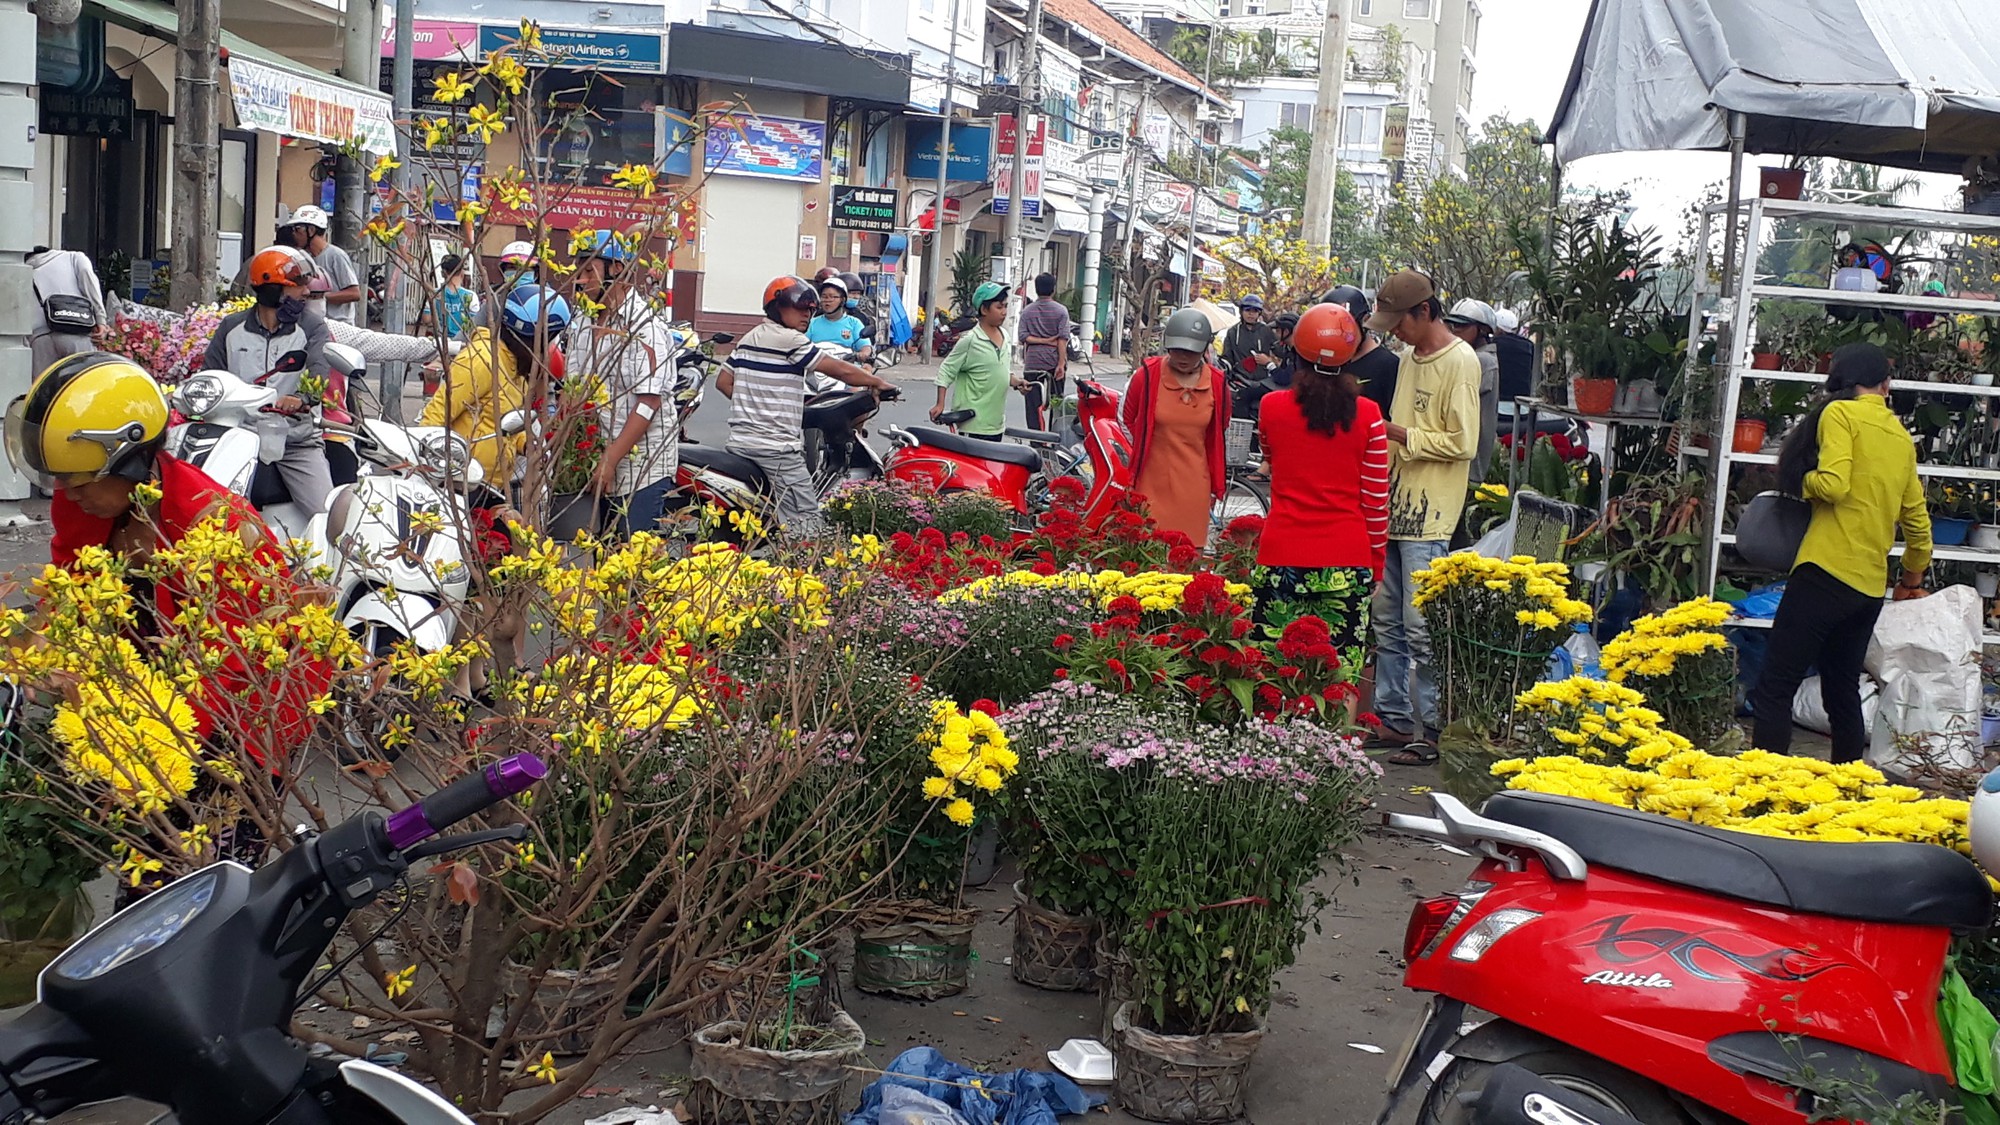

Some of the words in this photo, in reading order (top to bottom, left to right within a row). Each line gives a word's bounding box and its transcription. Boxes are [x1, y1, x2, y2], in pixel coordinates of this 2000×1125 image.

[576, 43, 614, 56] Airlines
[1385, 125, 1406, 138] VIVA
[999, 157, 1040, 166] RESTANT
[874, 207, 893, 218] TOUR
[1583, 970, 1673, 988] Attila
